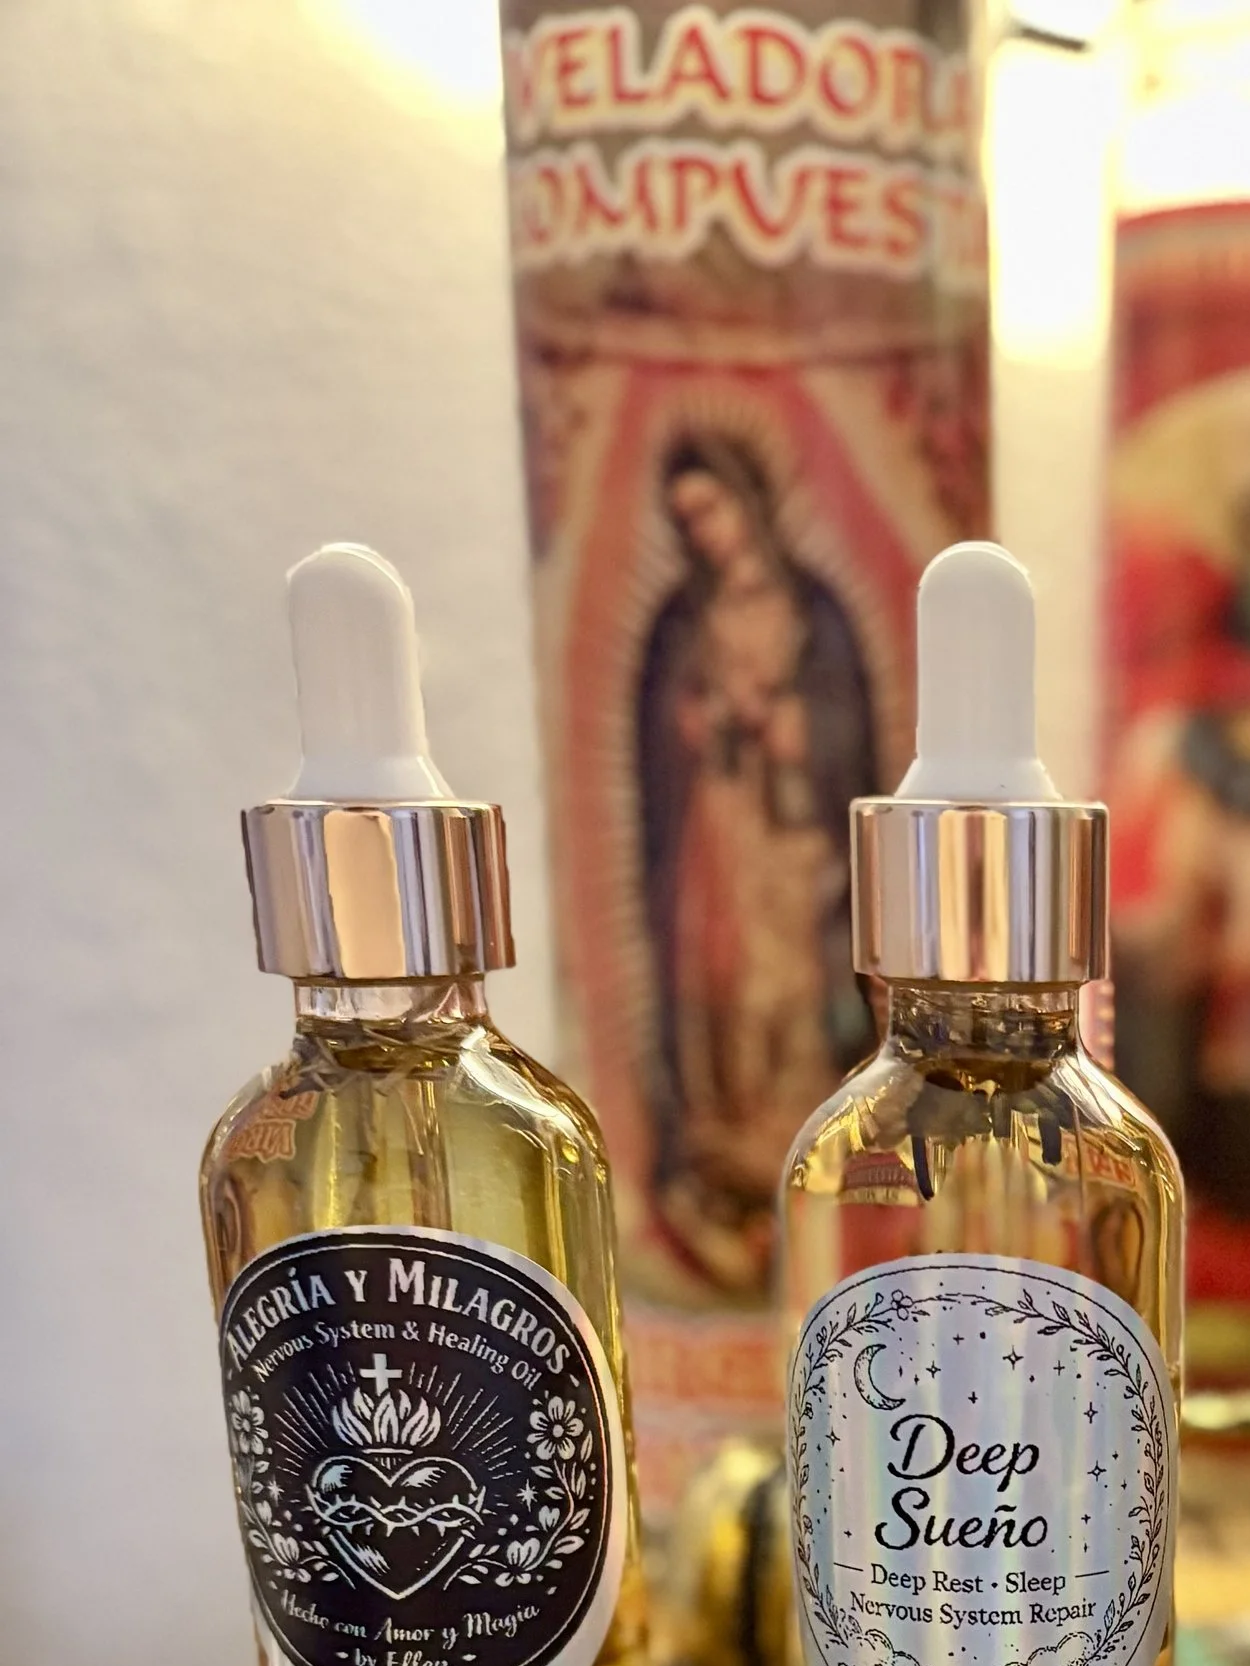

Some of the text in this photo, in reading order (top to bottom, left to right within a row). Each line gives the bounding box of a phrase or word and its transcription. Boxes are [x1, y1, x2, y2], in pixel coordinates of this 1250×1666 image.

[227, 1267, 336, 1374] ALEGRÍA
[345, 1270, 367, 1302] Y
[388, 1258, 571, 1374] MILAGROS
[252, 1321, 543, 1392] Nervous System & Healing Oil
[887, 1413, 1040, 1493] Deep
[874, 1486, 1050, 1551] Sueño
[850, 1591, 1097, 1630] Nervous System Repair
[871, 1563, 1066, 1596] Deep Rest Sleep
[374, 1617, 435, 1644] Amor
[463, 1604, 540, 1638] Magia
